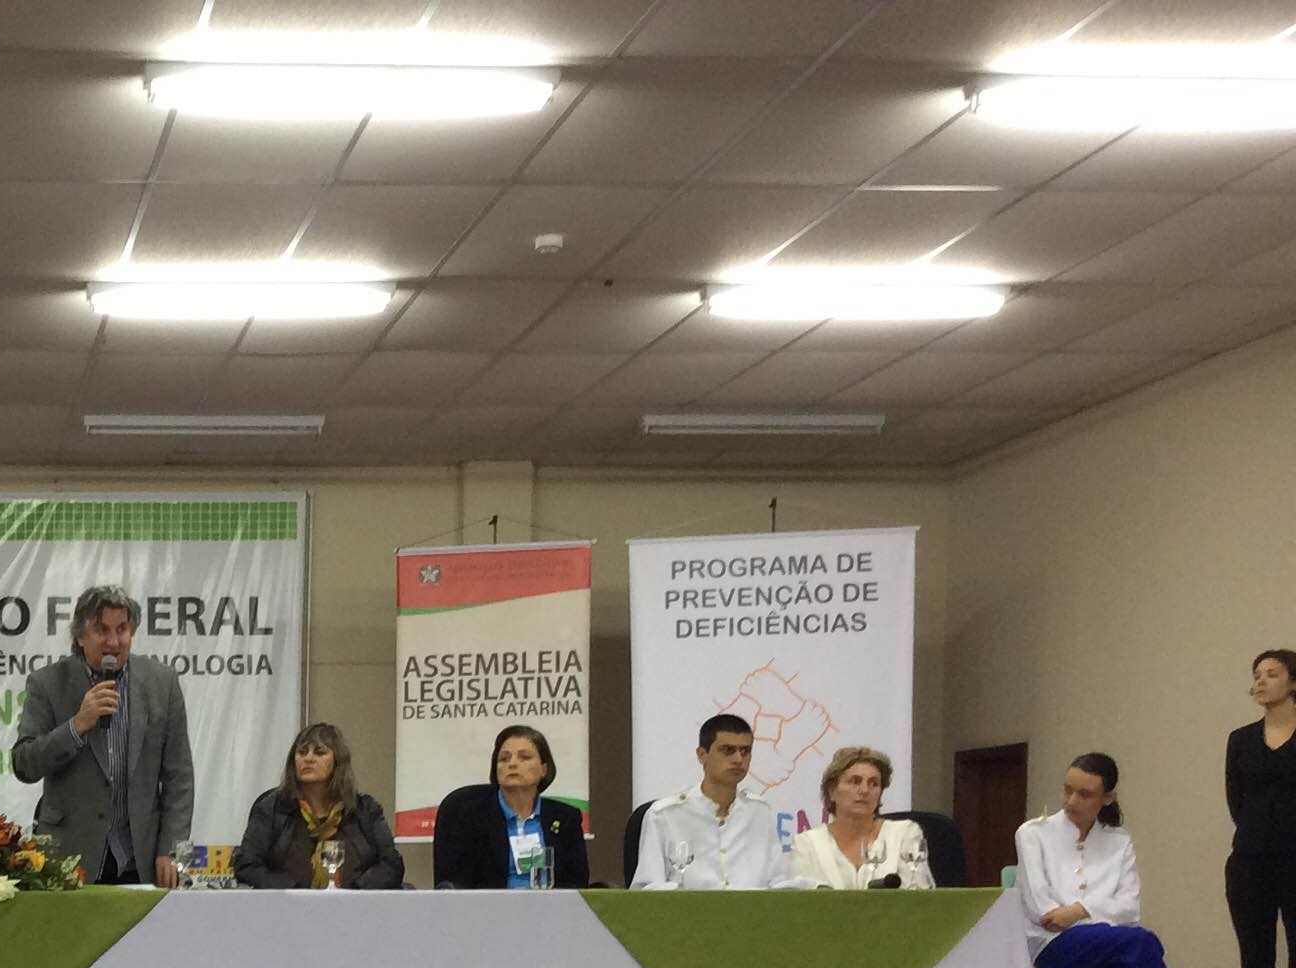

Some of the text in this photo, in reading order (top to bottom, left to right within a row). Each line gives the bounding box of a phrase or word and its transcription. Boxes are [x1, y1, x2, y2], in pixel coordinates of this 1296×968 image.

[671, 552, 873, 580] PROGRAMA DE
[664, 580, 879, 610] PREVENÇÃO DE
[47, 596, 273, 636] FERAL
[675, 610, 868, 639] DEFICIÊNCIAS
[403, 649, 583, 678] ASSEMBLEIA
[404, 675, 582, 703] LEGISLATIVA
[403, 699, 583, 720] DE SANTA CATARINA
